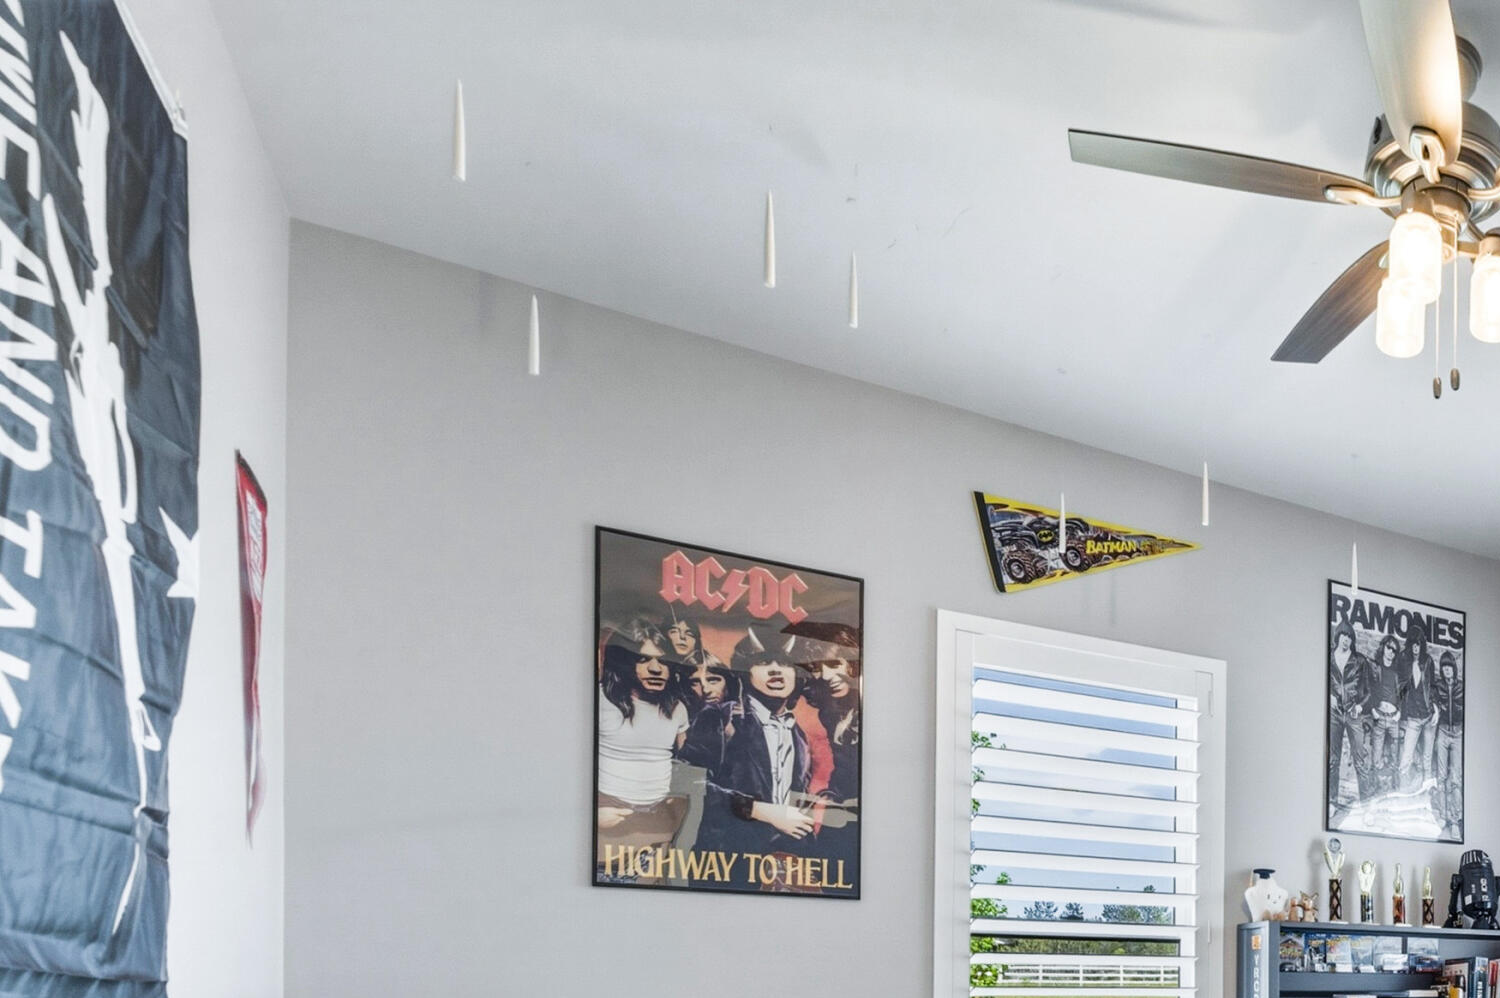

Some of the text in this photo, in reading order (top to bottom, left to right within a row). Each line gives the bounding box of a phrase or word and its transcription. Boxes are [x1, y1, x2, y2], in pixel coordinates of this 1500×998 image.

[0, 216, 57, 472] AND
[1331, 592, 1464, 650] RAMONES
[604, 844, 853, 889] HIGHWAY TO HELL
